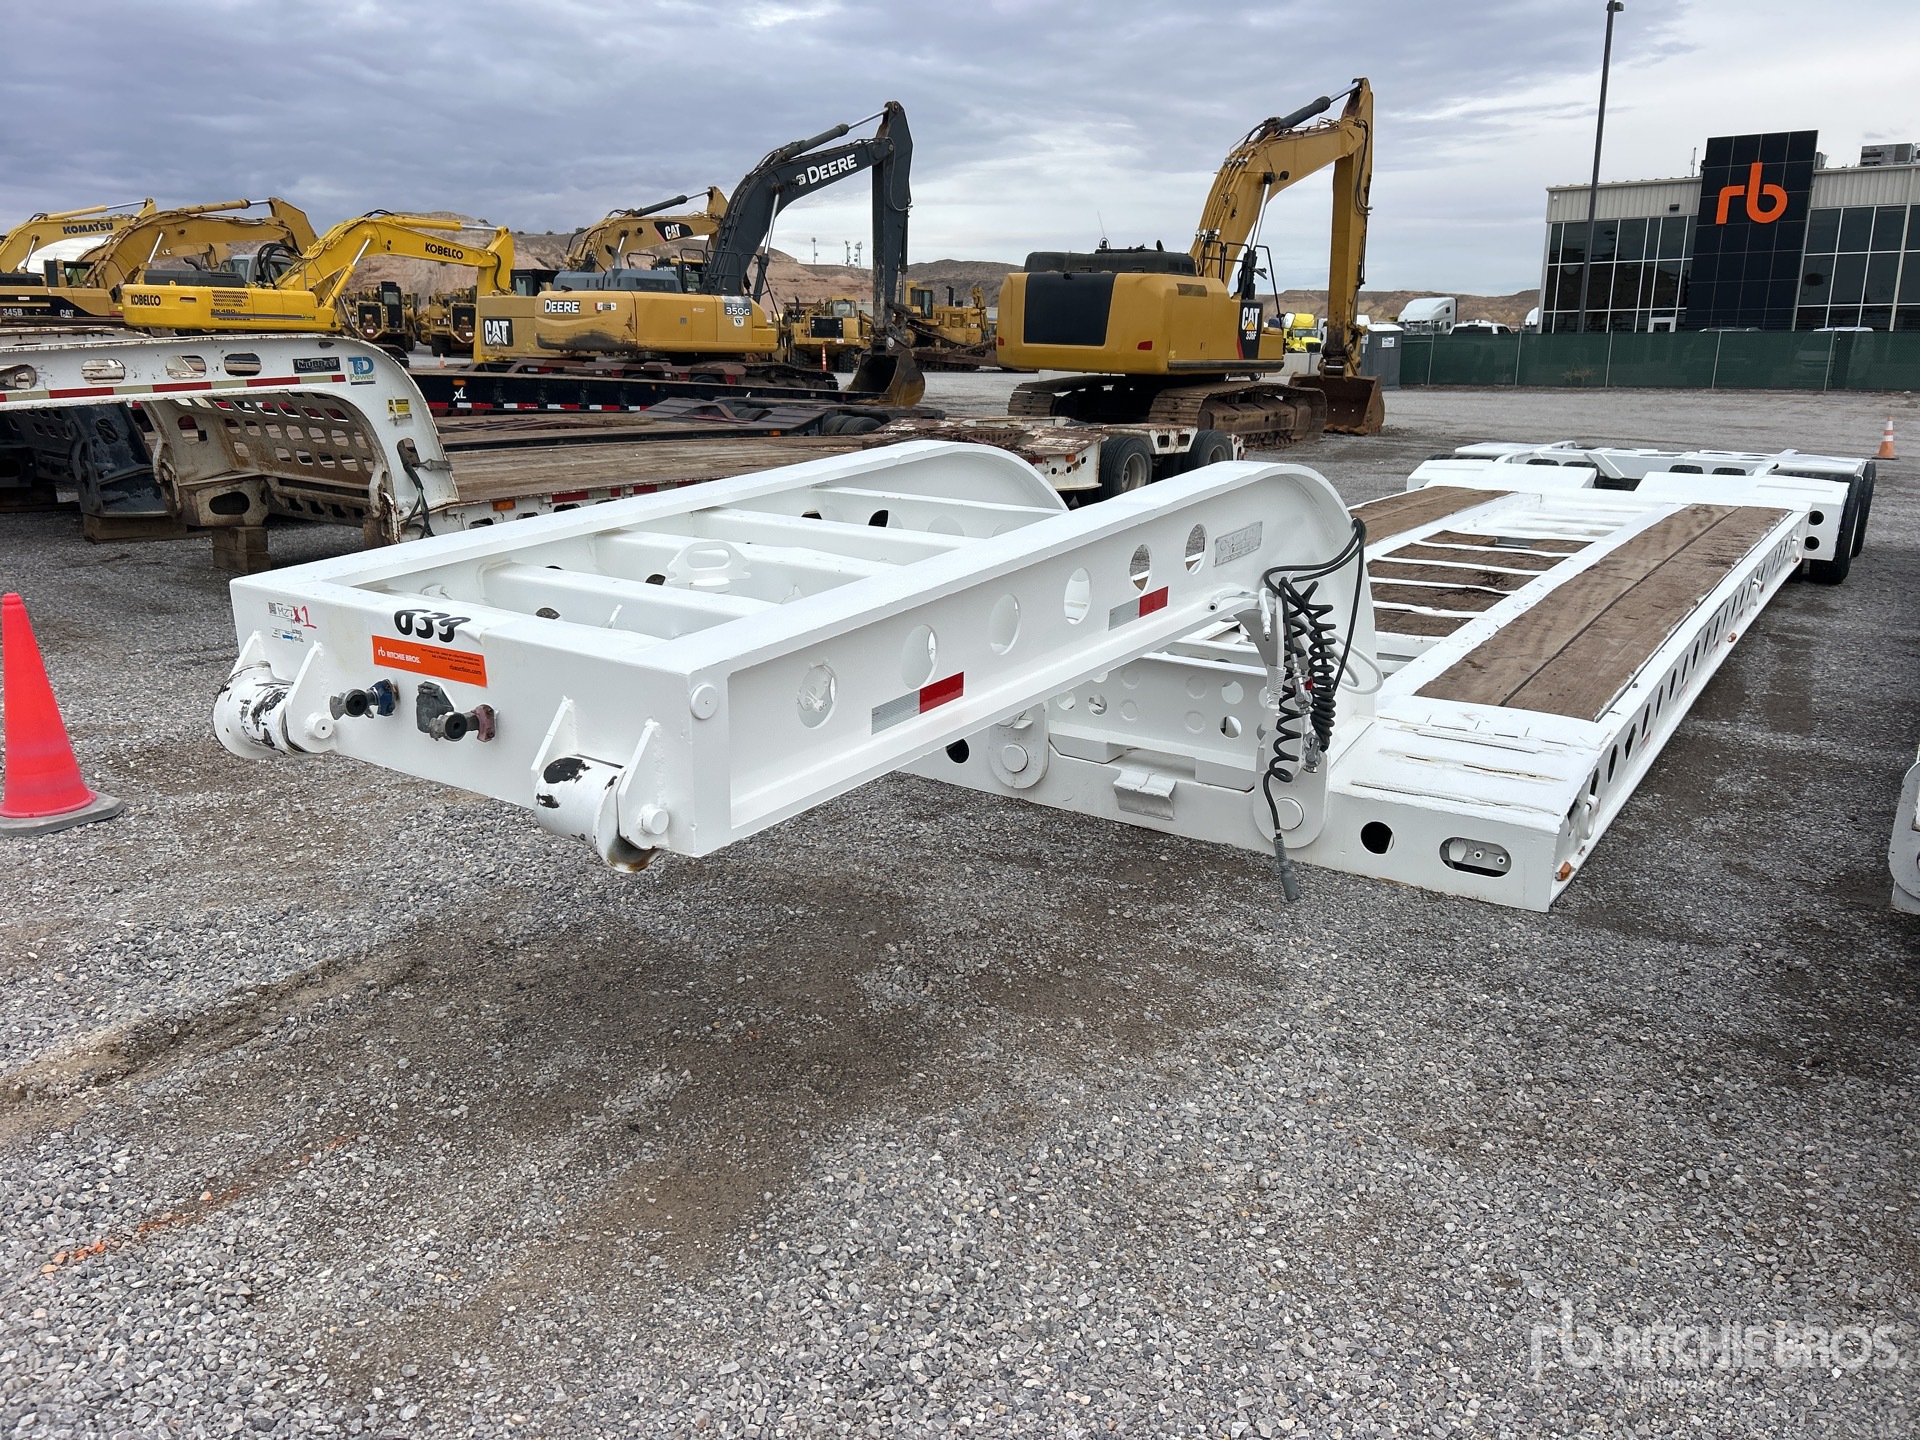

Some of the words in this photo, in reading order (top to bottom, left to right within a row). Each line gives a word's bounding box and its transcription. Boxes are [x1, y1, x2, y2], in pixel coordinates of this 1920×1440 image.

[806, 153, 858, 185] DEERE
[1715, 161, 1788, 225] rb
[62, 221, 114, 235] KOMATSU
[664, 223, 681, 241] CAT
[425, 242, 464, 260] KOBELCO
[130, 294, 161, 307] KOBELCO
[543, 299, 580, 314] DEERE
[2, 308, 23, 317] 345B
[59, 309, 75, 319] CAT
[725, 306, 750, 316] 350G
[1241, 306, 1260, 331] CAT
[484, 319, 510, 346] CAT
[349, 373, 375, 381] Power
[452, 387, 467, 401] XL
